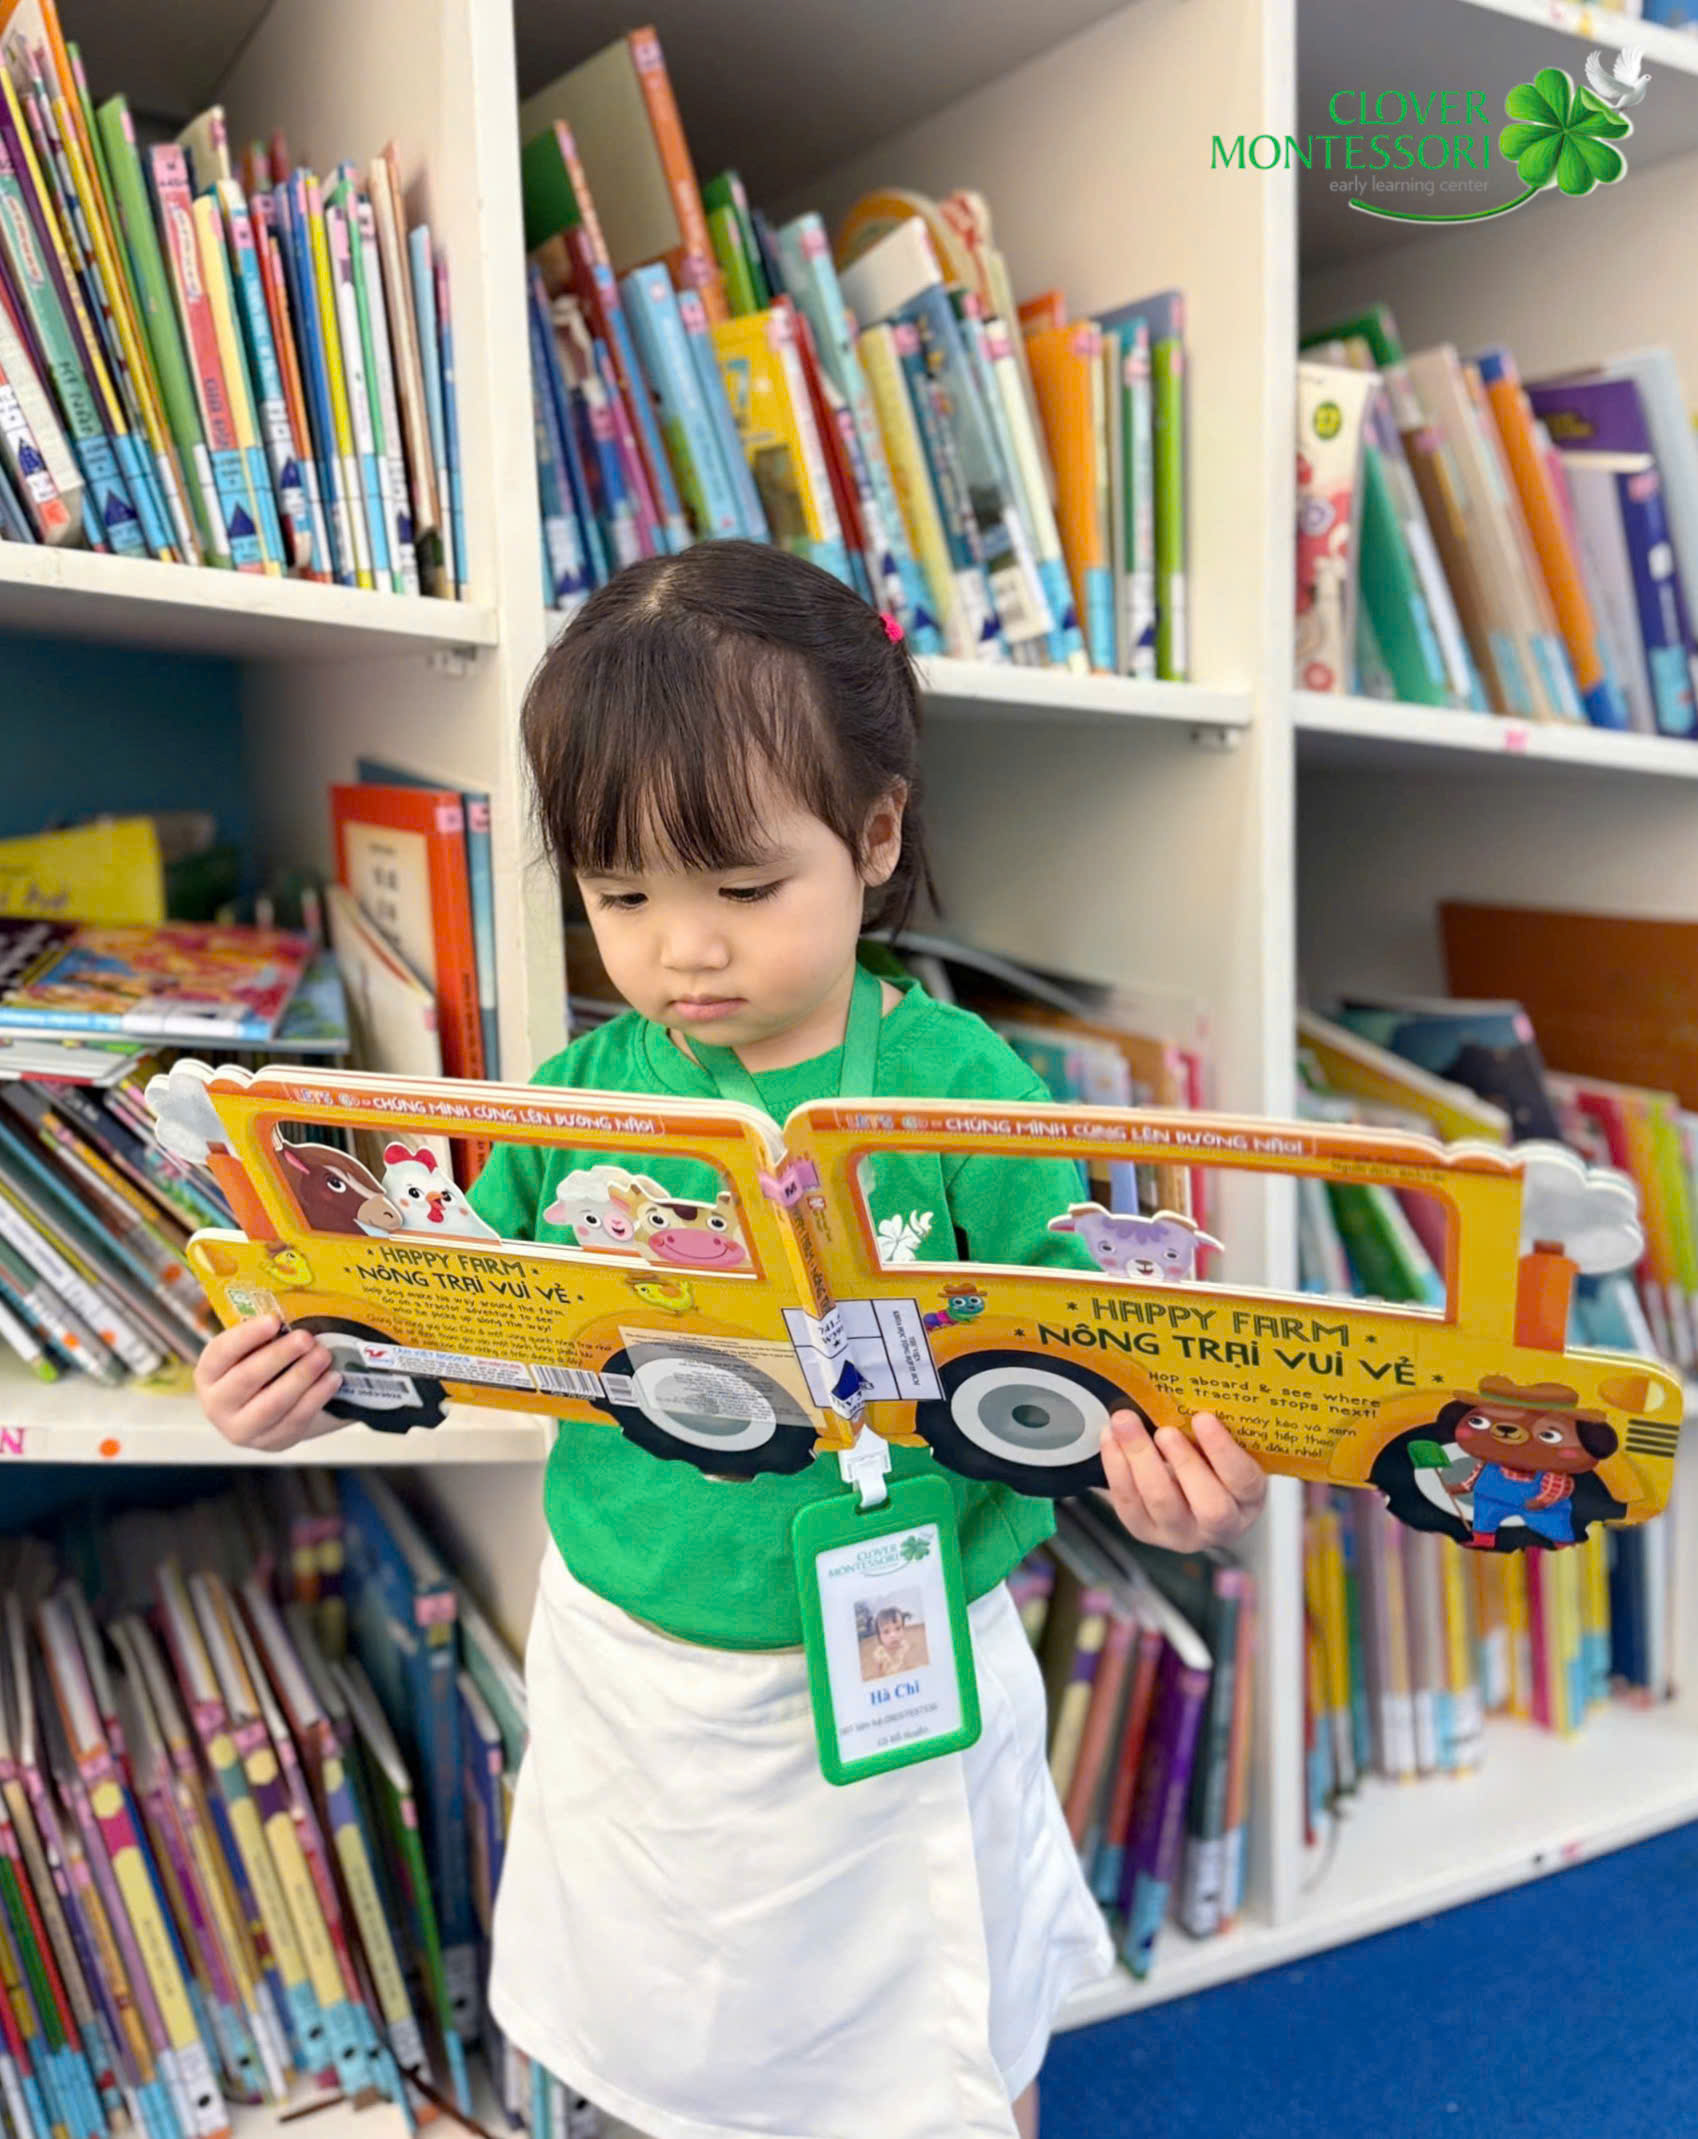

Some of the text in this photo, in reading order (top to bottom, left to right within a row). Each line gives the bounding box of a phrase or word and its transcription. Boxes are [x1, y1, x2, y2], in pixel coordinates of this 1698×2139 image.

[945, 1116, 1011, 1134] CHÚNG
[379, 1246, 527, 1278] HAPPY FARM
[356, 1264, 430, 1287] NÔNG
[535, 1282, 572, 1304] VẺ
[1091, 1297, 1350, 1347] HAPPY FARM
[1038, 1322, 1160, 1356] NÔNG
[1358, 1356, 1417, 1387] VẺ
[1149, 1371, 1381, 1408] Hop aboard & see where
[1155, 1383, 1377, 1419] the tractor stops next!
[870, 1688, 892, 1706] Hà
